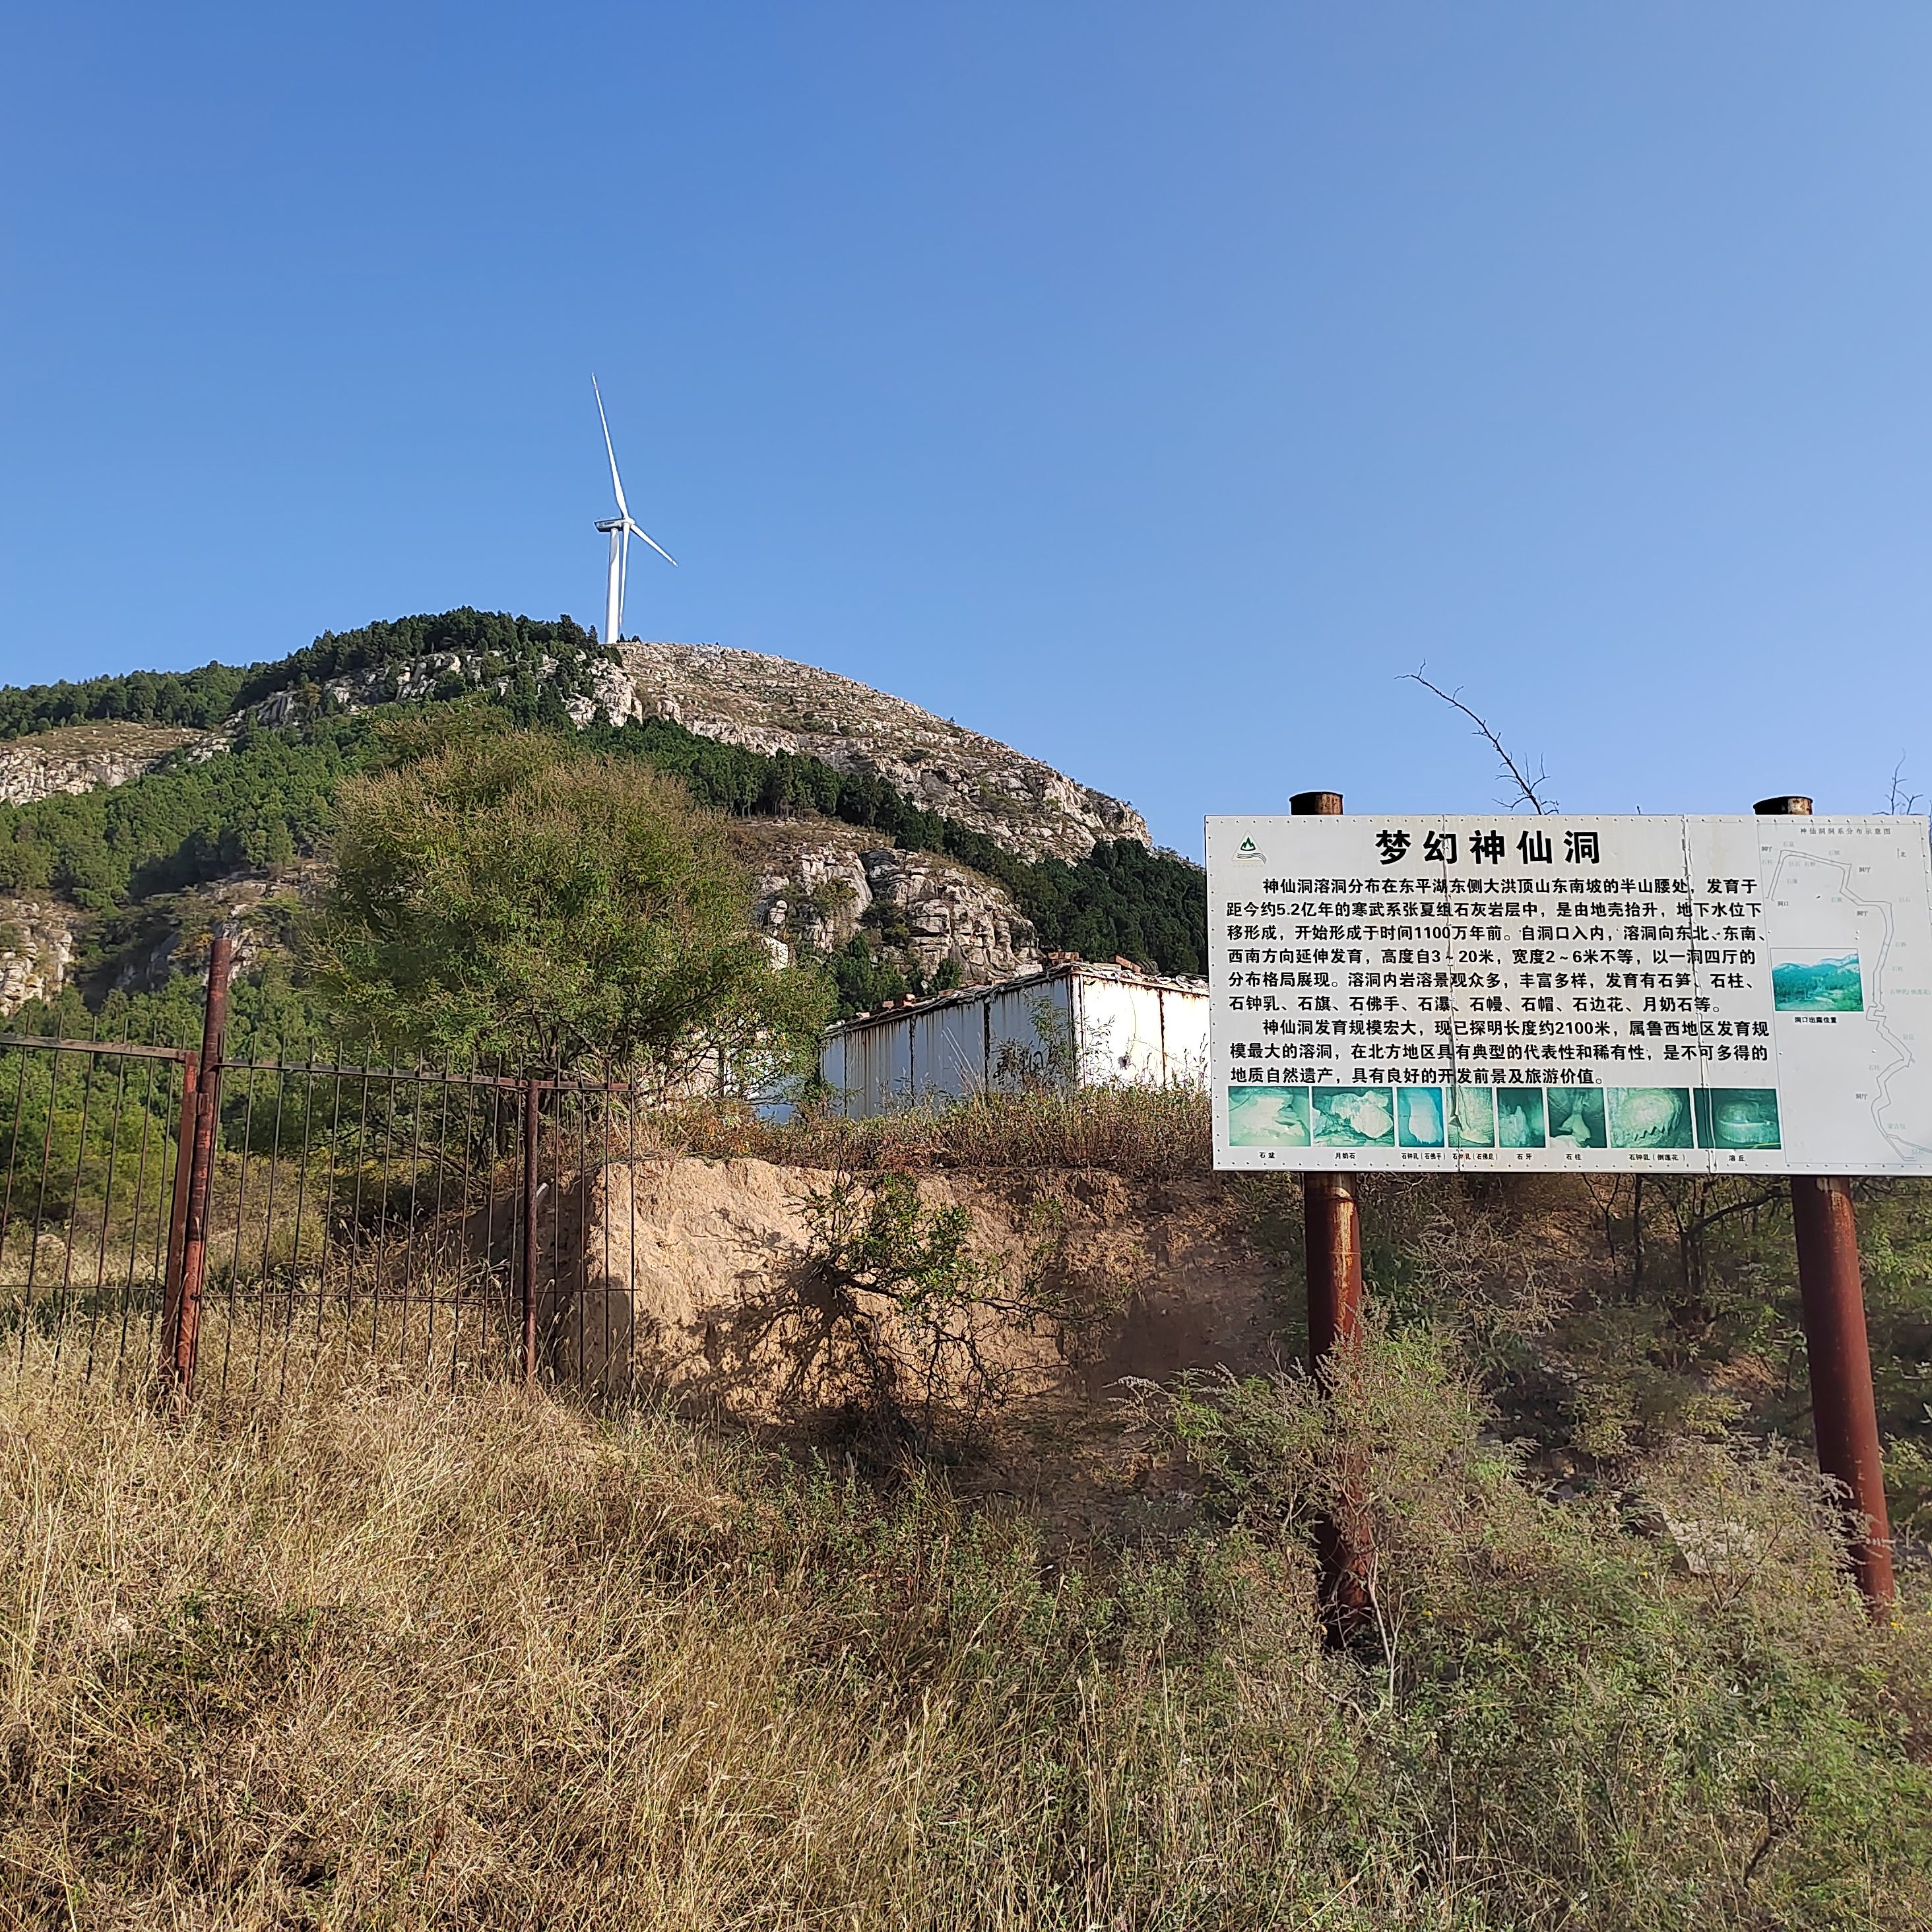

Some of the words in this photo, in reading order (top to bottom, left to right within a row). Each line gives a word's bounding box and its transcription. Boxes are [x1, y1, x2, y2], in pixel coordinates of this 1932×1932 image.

[1375, 829, 1600, 865] 梦幻神仙洞
[1231, 1068, 1603, 1084] 地质自然遗产，具有良好的开发前景及旅游价值。
